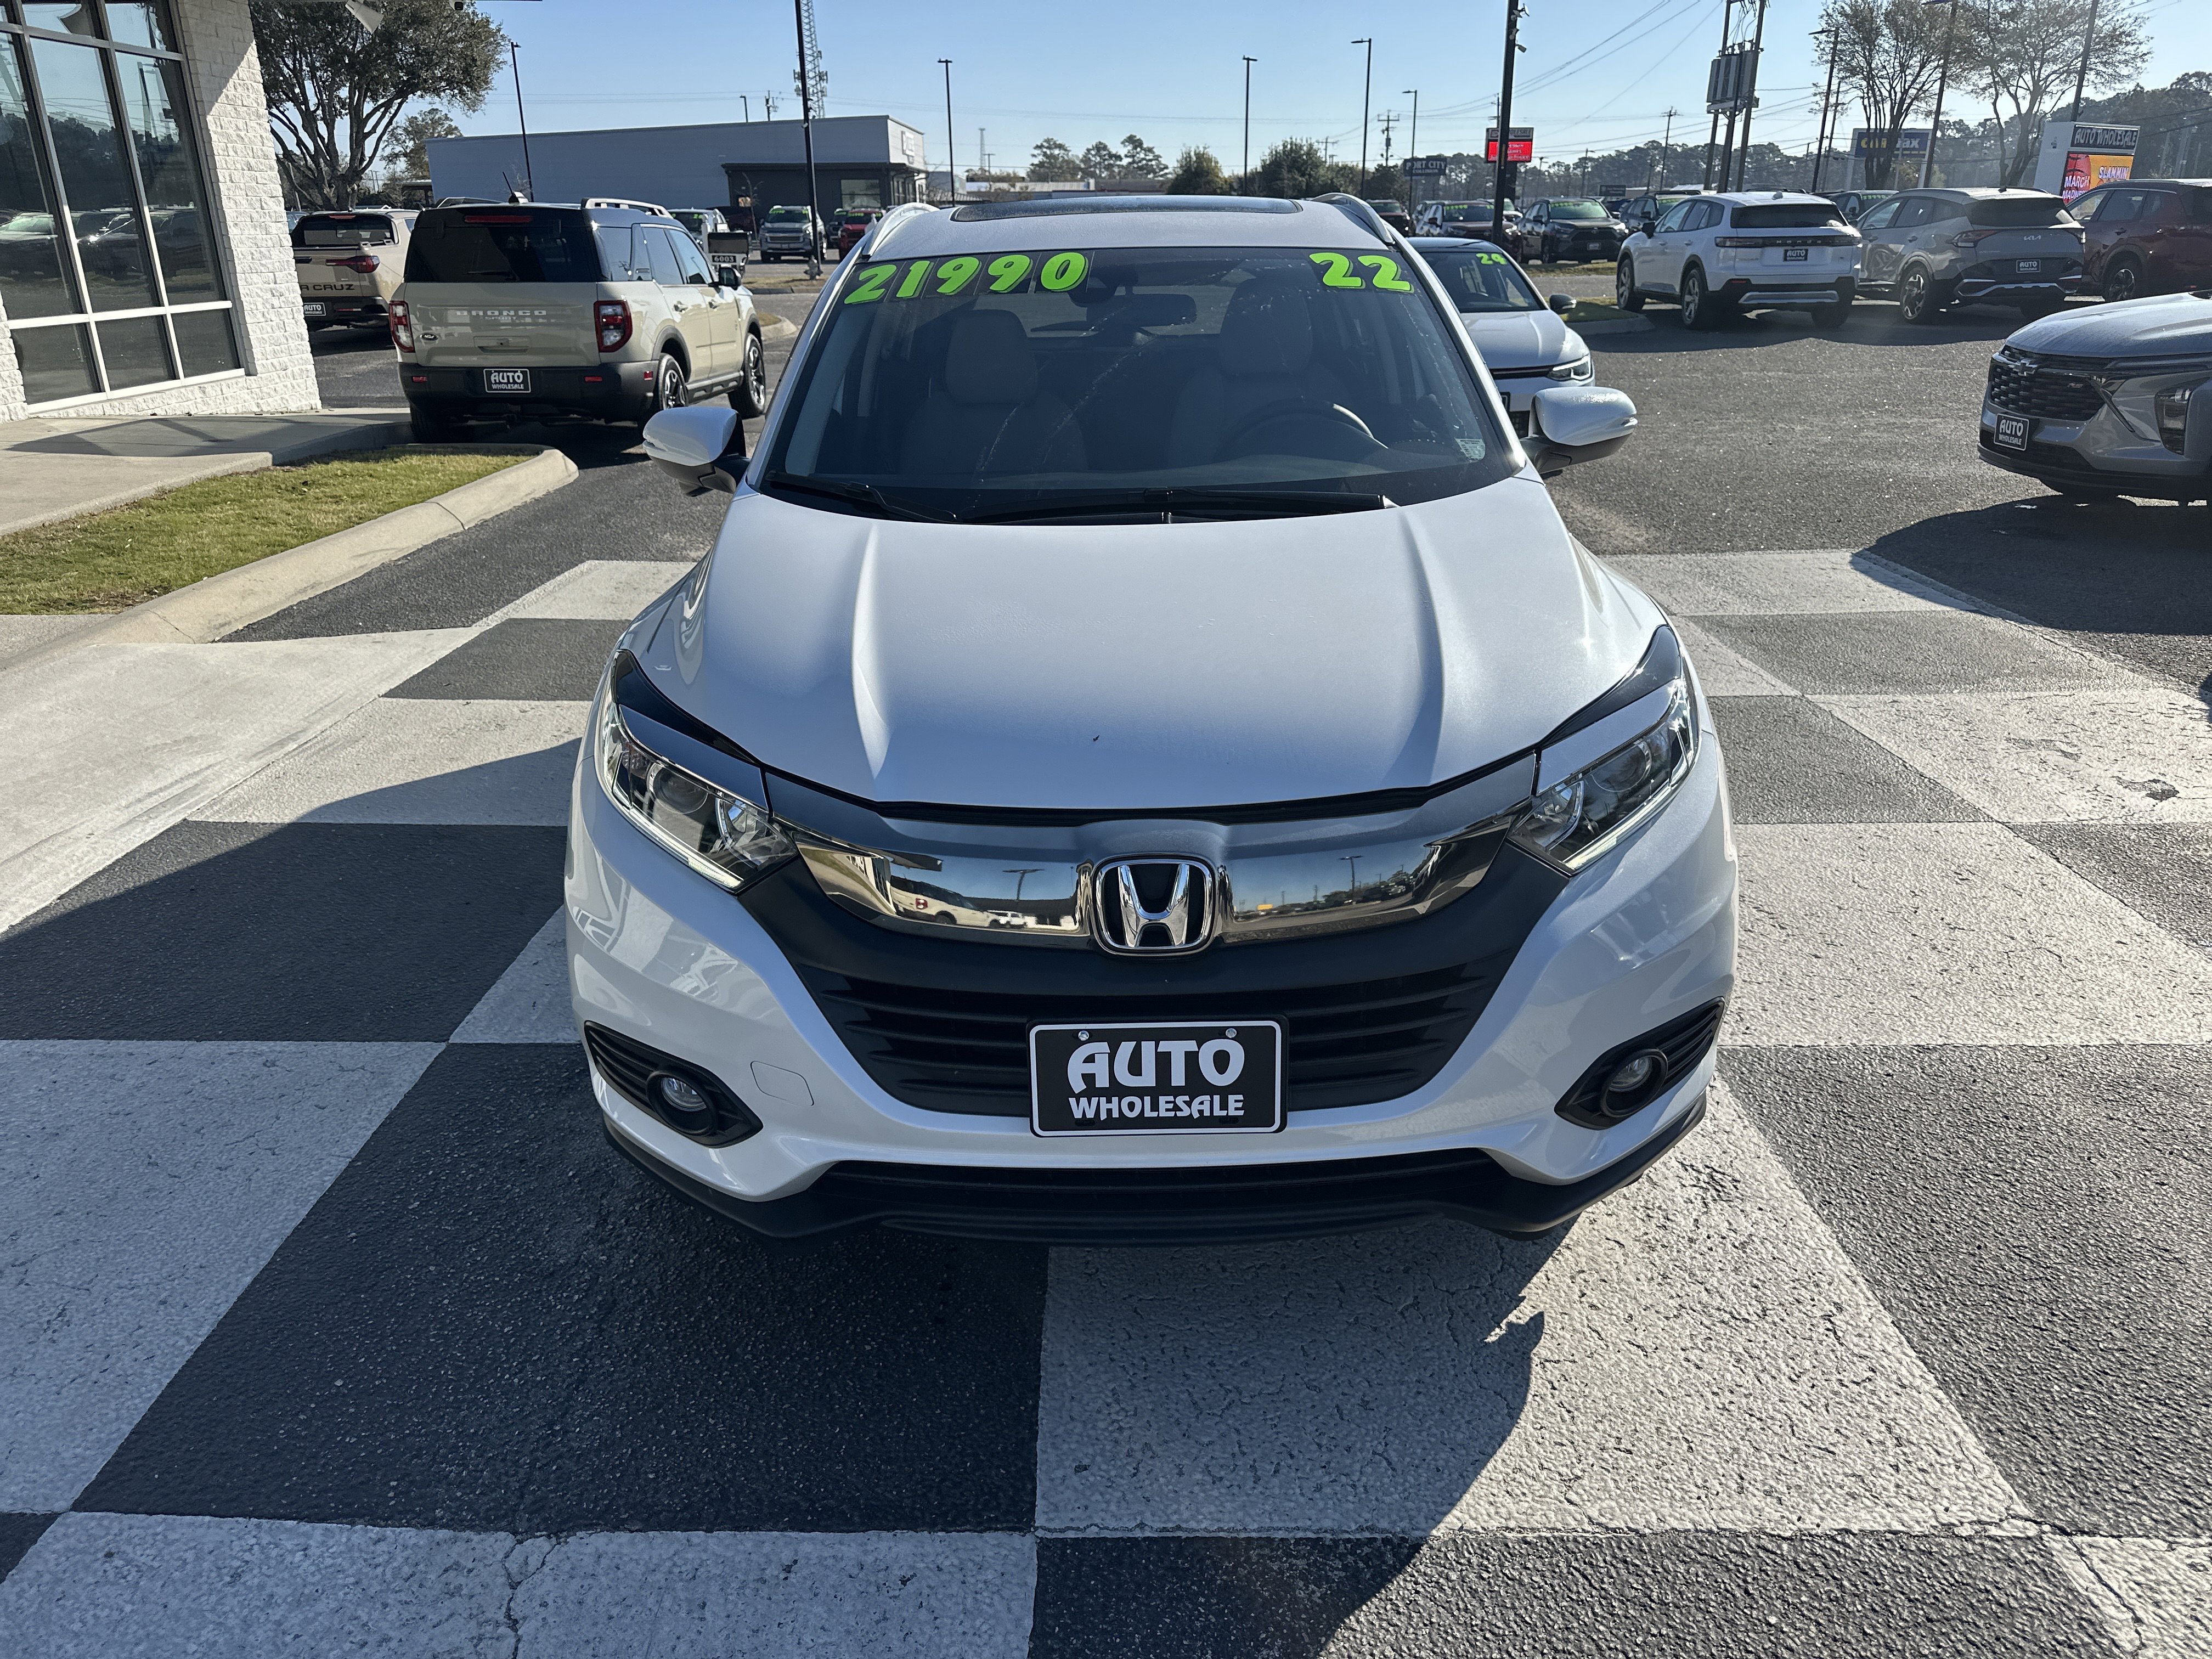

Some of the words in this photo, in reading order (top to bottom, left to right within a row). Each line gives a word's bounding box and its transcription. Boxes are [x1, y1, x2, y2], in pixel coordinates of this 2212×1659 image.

[2074, 128, 2096, 144] AUTO
[2096, 129, 2137, 147] WHOLESALE
[1428, 161, 1446, 169] CITY
[2098, 166, 2130, 180] SLAMMIN
[2064, 175, 2090, 188] MARCH
[844, 252, 1088, 304] 21990
[1309, 252, 1415, 294] 22
[490, 371, 523, 383] AUTO
[1999, 419, 2024, 437] AUTO
[1999, 433, 2022, 445] WHOLESALE
[1067, 1039, 1245, 1094] AUTO
[1068, 1094, 1245, 1121] WHOLESALE
